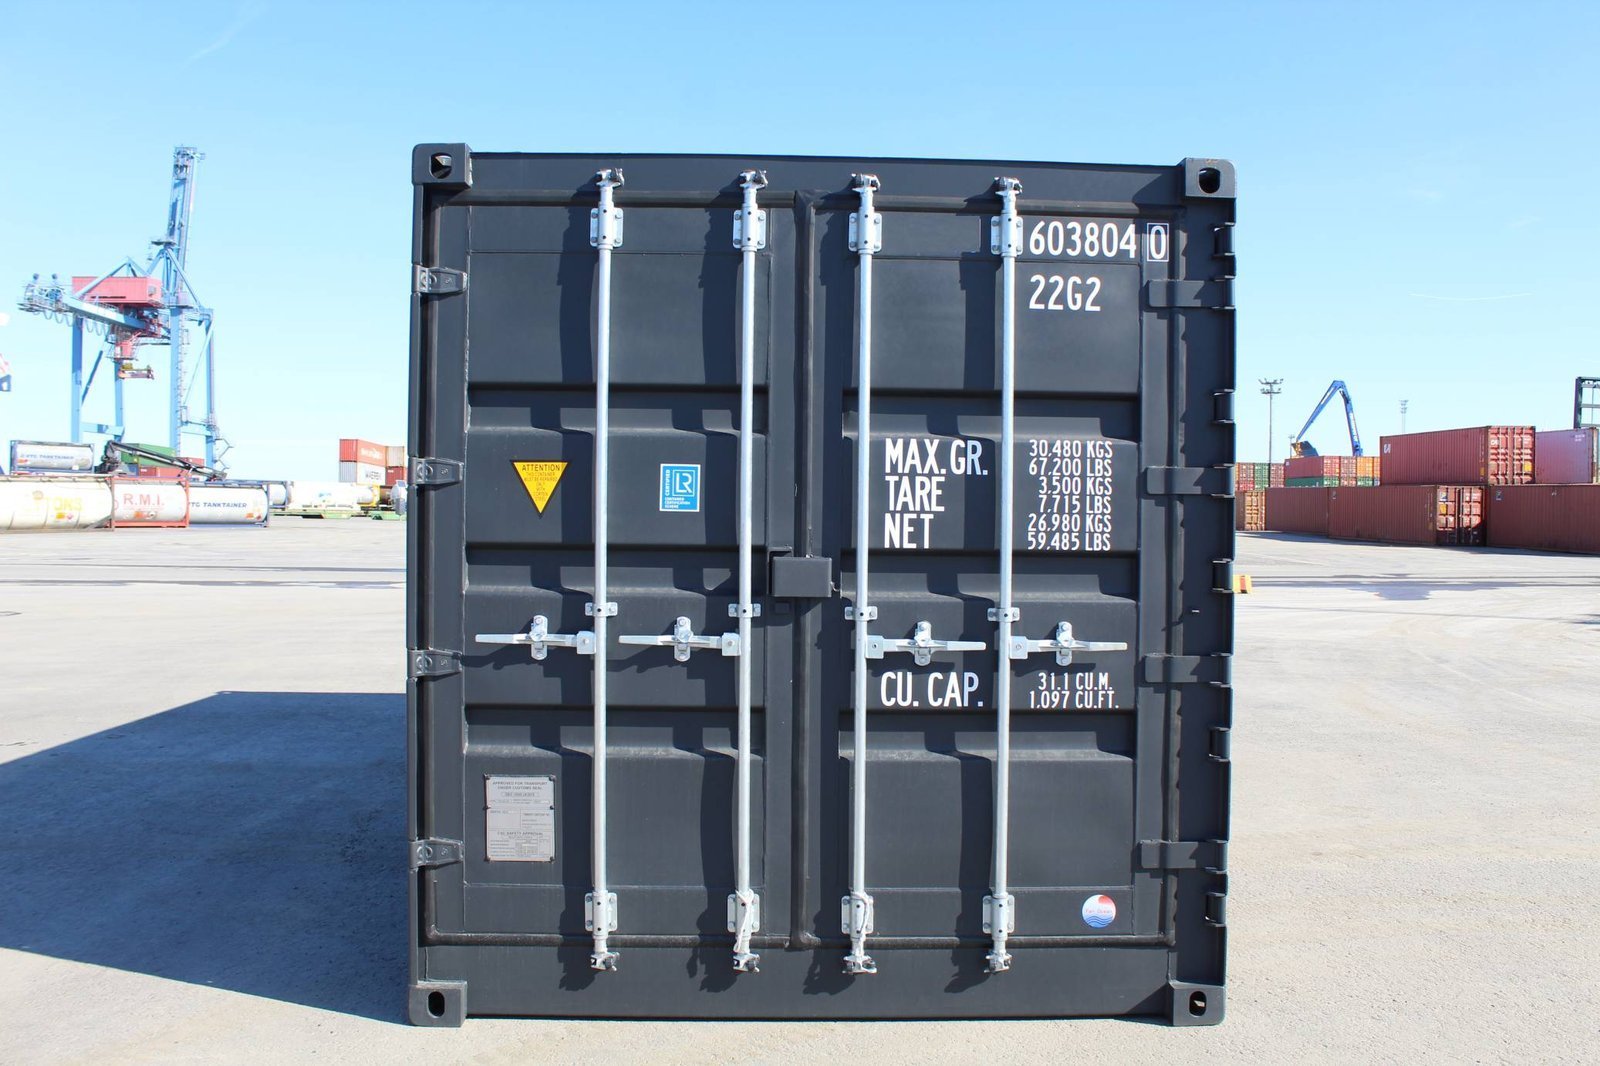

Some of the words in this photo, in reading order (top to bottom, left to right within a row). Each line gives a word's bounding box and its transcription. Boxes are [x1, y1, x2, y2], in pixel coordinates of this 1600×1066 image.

[1029, 221, 1137, 259] 603804
[1149, 225, 1167, 260] 0
[1029, 274, 1102, 312] 22G2
[885, 438, 947, 475] MAX.
[950, 440, 989, 475] GR.
[1029, 439, 1082, 458] 30,480
[1086, 440, 1113, 458] KGS
[1029, 457, 1082, 476] 67,200
[1086, 458, 1113, 477] LBS
[676, 472, 693, 493] LR
[1038, 476, 1082, 495] 3,500
[1086, 477, 1113, 496] KGS
[123, 493, 165, 506] R.M.I.
[885, 475, 946, 512] TARE
[1038, 494, 1081, 514] 7,715
[1085, 495, 1112, 514] LBS
[884, 512, 935, 549] NET
[1027, 513, 1081, 532] 26,980
[1085, 514, 1112, 532] KGS
[1027, 531, 1080, 551] 59,485
[1085, 532, 1111, 551] LBS
[880, 671, 920, 707] CU.
[928, 672, 984, 707] CAP.
[1038, 672, 1070, 690] 31.1
[1075, 672, 1113, 690] CU.M.
[1029, 690, 1070, 709] 1,097
[1075, 690, 1120, 709] CU.FT.
